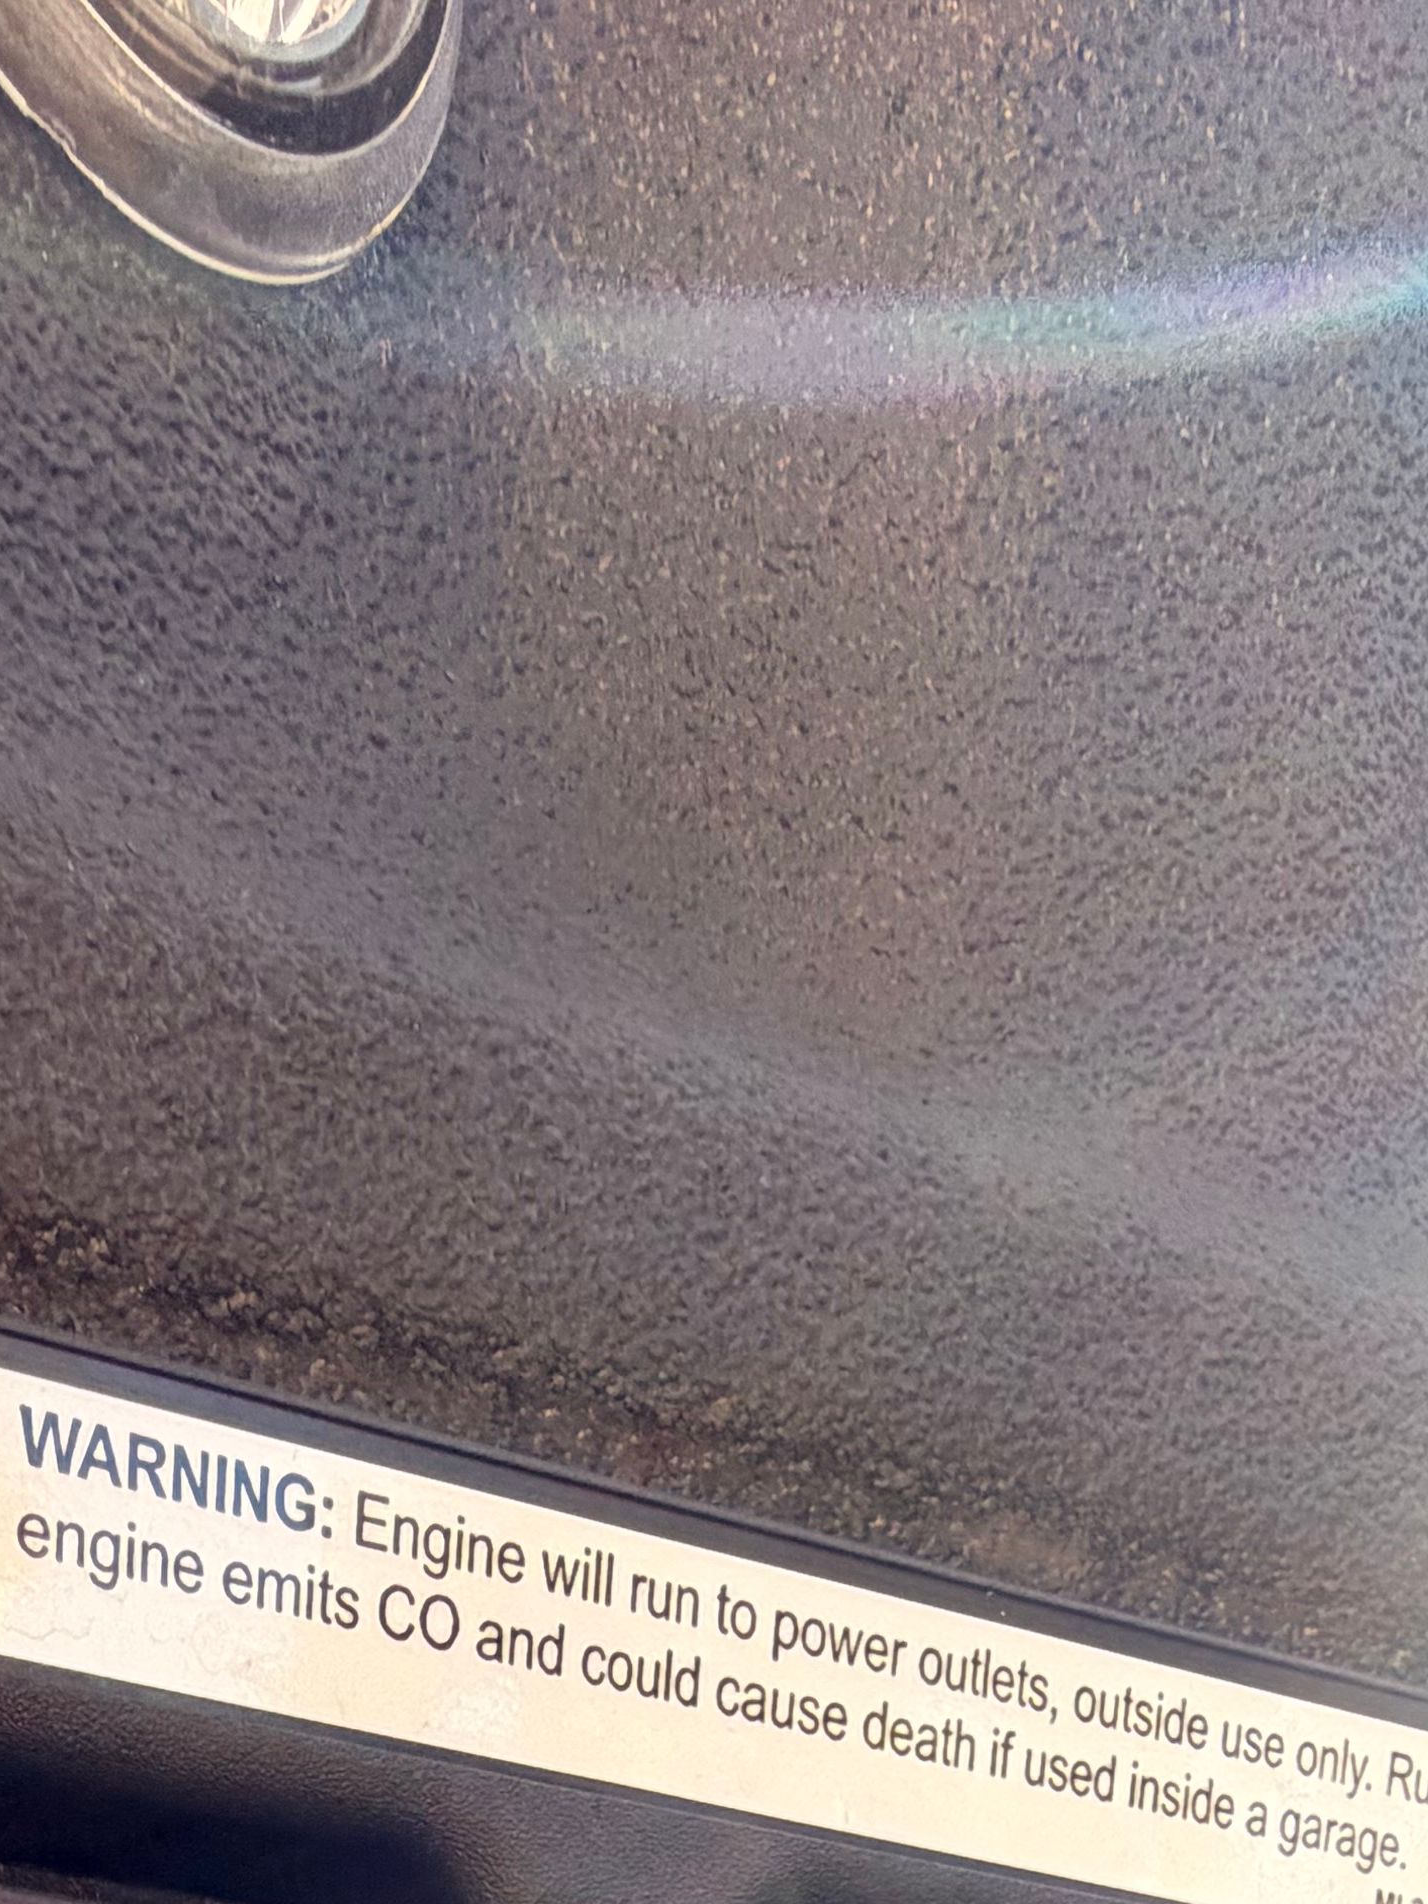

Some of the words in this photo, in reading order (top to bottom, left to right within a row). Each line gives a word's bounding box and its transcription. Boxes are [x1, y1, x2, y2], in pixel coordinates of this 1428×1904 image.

[17, 1511, 205, 1594] engine
[222, 1561, 361, 1630] emits
[379, 1585, 461, 1651] CO
[476, 1622, 565, 1677] and
[581, 1642, 702, 1708] could
[715, 1673, 847, 1744] cause
[863, 1700, 975, 1773] death
[989, 1727, 1016, 1780] if
[1024, 1744, 1116, 1808] used
[1128, 1761, 1235, 1833] inside
[1245, 1802, 1269, 1838] a
[1280, 1809, 1408, 1872] garage.
[19, 1403, 334, 1538] WARNING:
[355, 1490, 525, 1584] Engine
[542, 1547, 614, 1607] will
[632, 1572, 699, 1628] run
[717, 1584, 758, 1641] to
[773, 1605, 907, 1680] power
[919, 1643, 1060, 1725] outlets,
[1073, 1686, 1209, 1752] outside
[1222, 1722, 1283, 1769] use
[1295, 1736, 1374, 1794] only.
